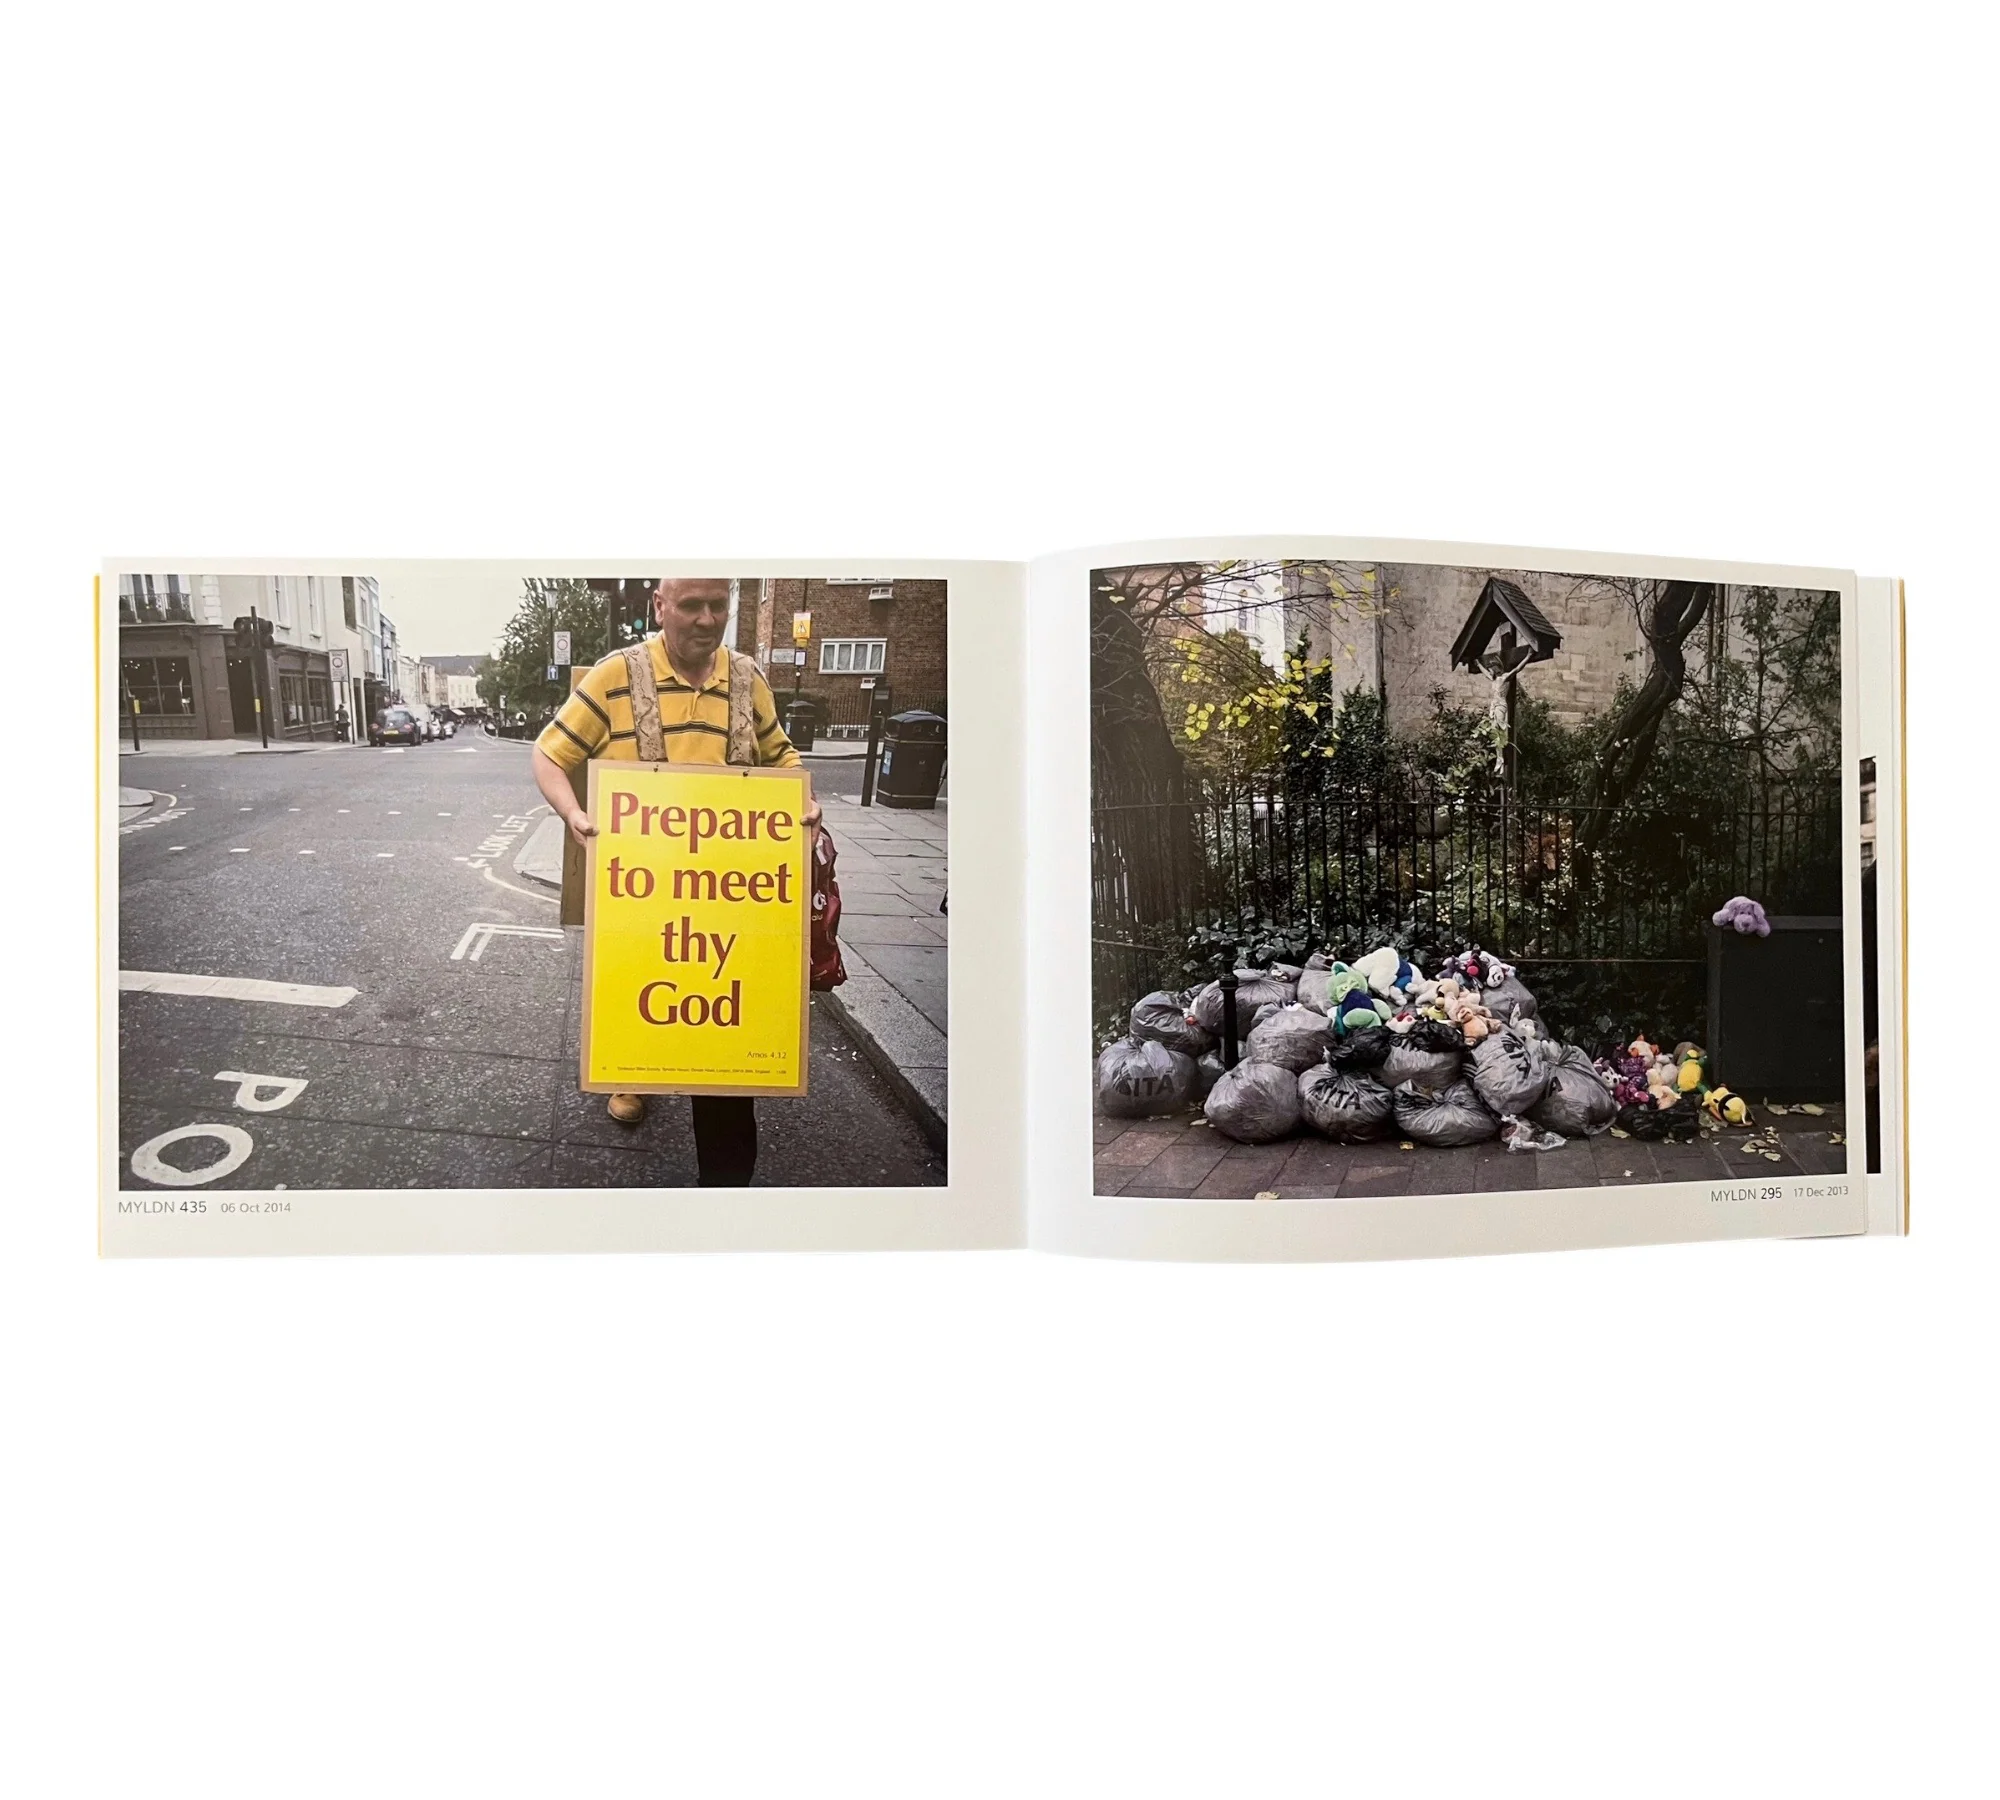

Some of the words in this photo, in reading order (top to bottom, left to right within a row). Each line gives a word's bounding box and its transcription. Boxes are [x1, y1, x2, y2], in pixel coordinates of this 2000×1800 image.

[610, 792, 793, 854] Prepare
[607, 856, 655, 898] to
[673, 863, 793, 904] meet
[661, 916, 737, 980] thy
[638, 979, 741, 1027] God
[746, 1050, 768, 1059] Amos
[118, 1200, 175, 1214] MYLDN
[179, 1200, 208, 1214] 435
[220, 1202, 236, 1214] 06
[239, 1202, 260, 1214] Oct
[263, 1202, 291, 1214] 2014
[1710, 1188, 1757, 1203] MYLDN
[1760, 1186, 1783, 1200] 295
[1793, 1187, 1804, 1198] 17
[1806, 1187, 1825, 1198] Dec
[1826, 1185, 1849, 1197] 2013
